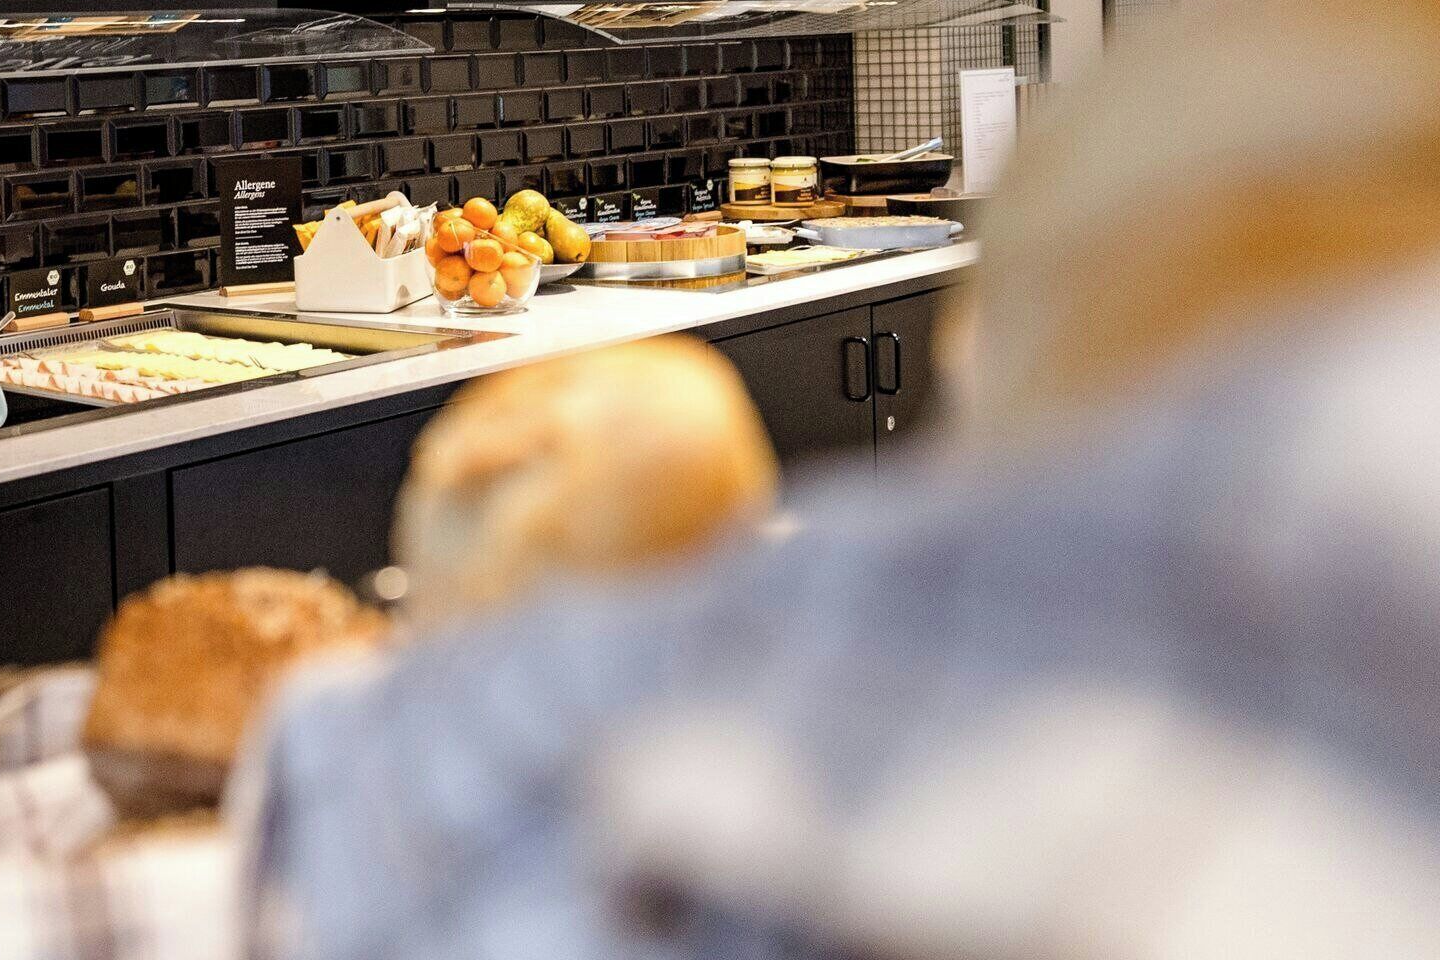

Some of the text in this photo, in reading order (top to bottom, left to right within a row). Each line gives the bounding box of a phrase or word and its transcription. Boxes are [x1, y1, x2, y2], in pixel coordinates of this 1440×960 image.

[234, 180, 275, 191] Allergene
[234, 191, 265, 200] Allergens
[100, 281, 126, 292] Gouda
[14, 288, 59, 301] Emmentaler
[18, 300, 54, 312] Emmental
